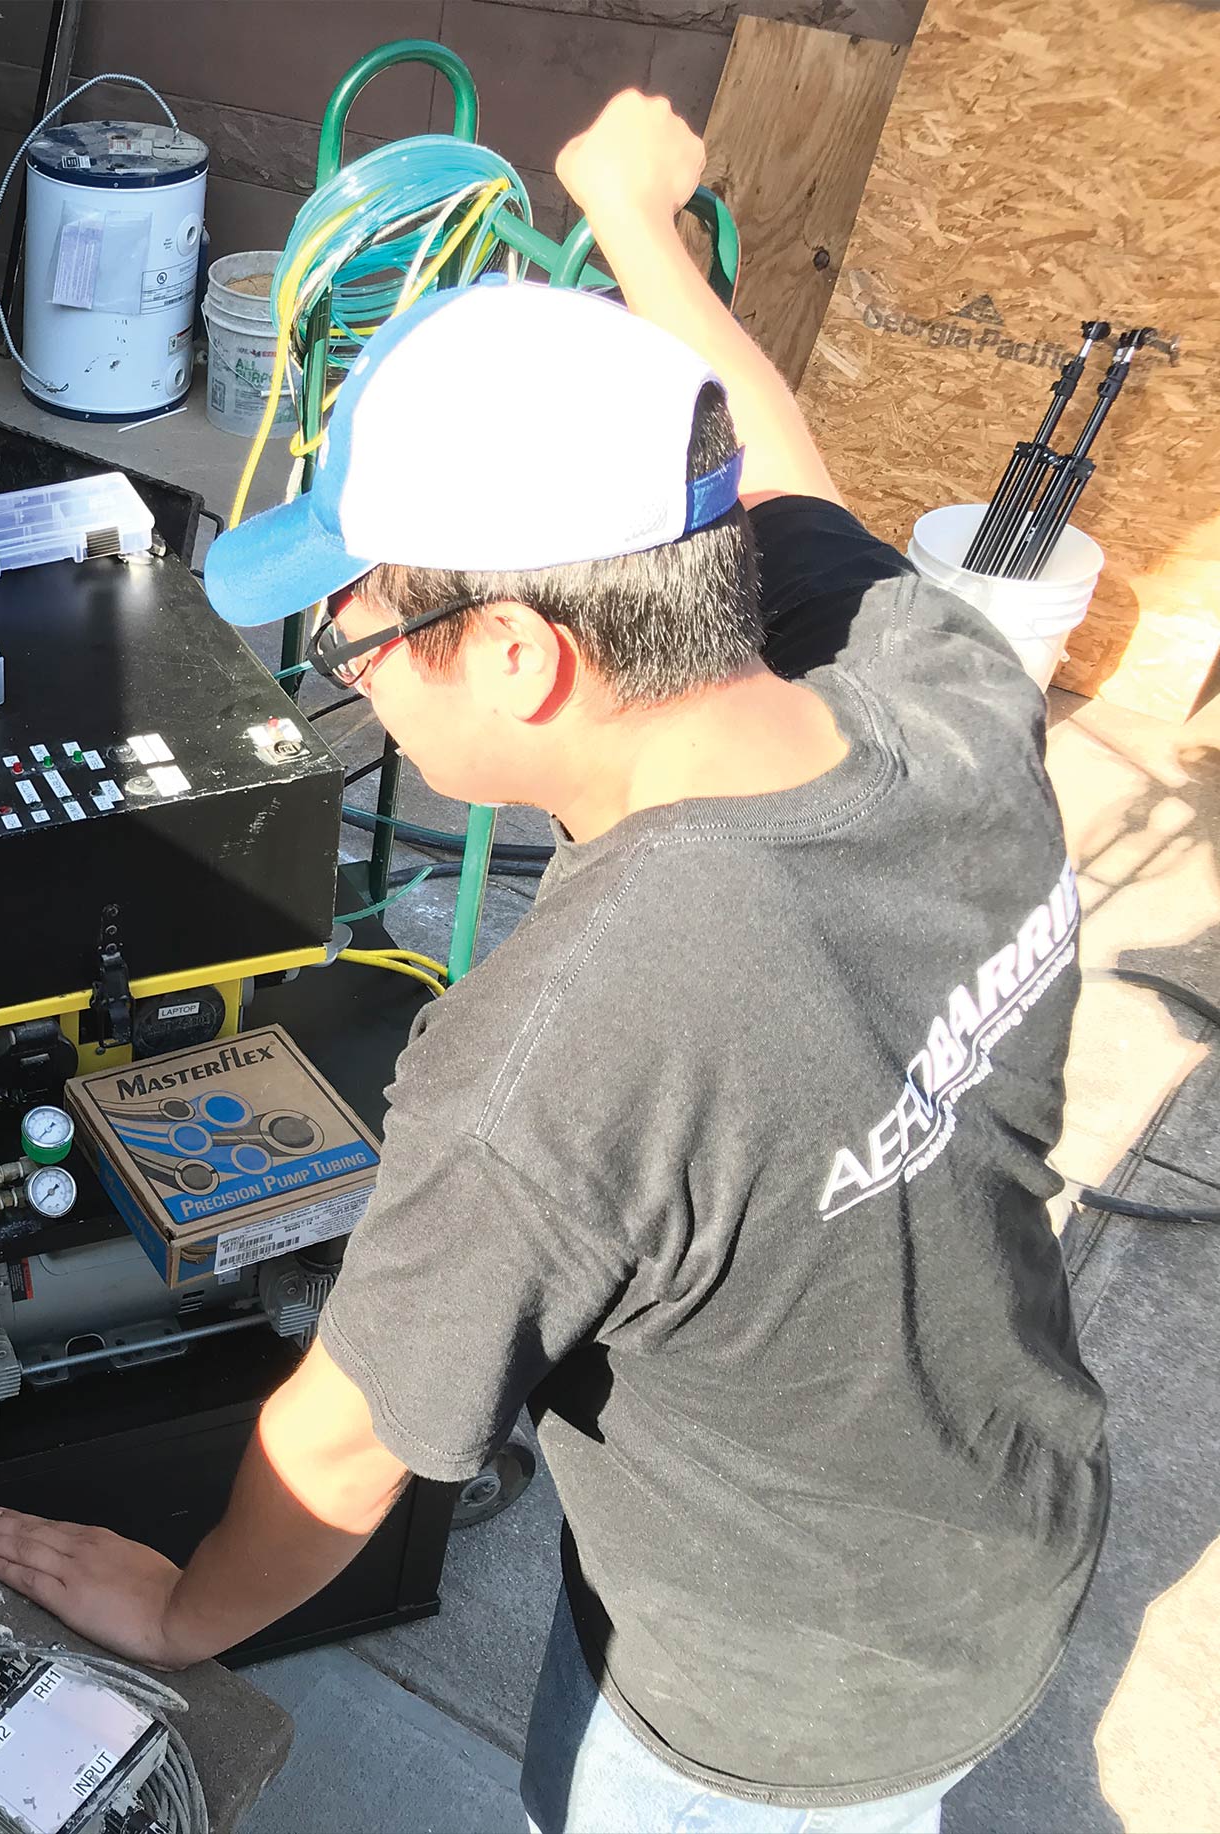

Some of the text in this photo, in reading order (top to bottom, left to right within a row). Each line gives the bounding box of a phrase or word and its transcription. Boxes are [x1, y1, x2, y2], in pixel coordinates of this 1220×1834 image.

[161, 1005, 197, 1017] LAPTOP
[180, 1182, 261, 1217] PRECISION
[262, 1170, 311, 1192] PUMP
[309, 1152, 368, 1178] TUBING
[32, 1668, 63, 1700] RH1
[72, 1752, 113, 1797] INPUT
